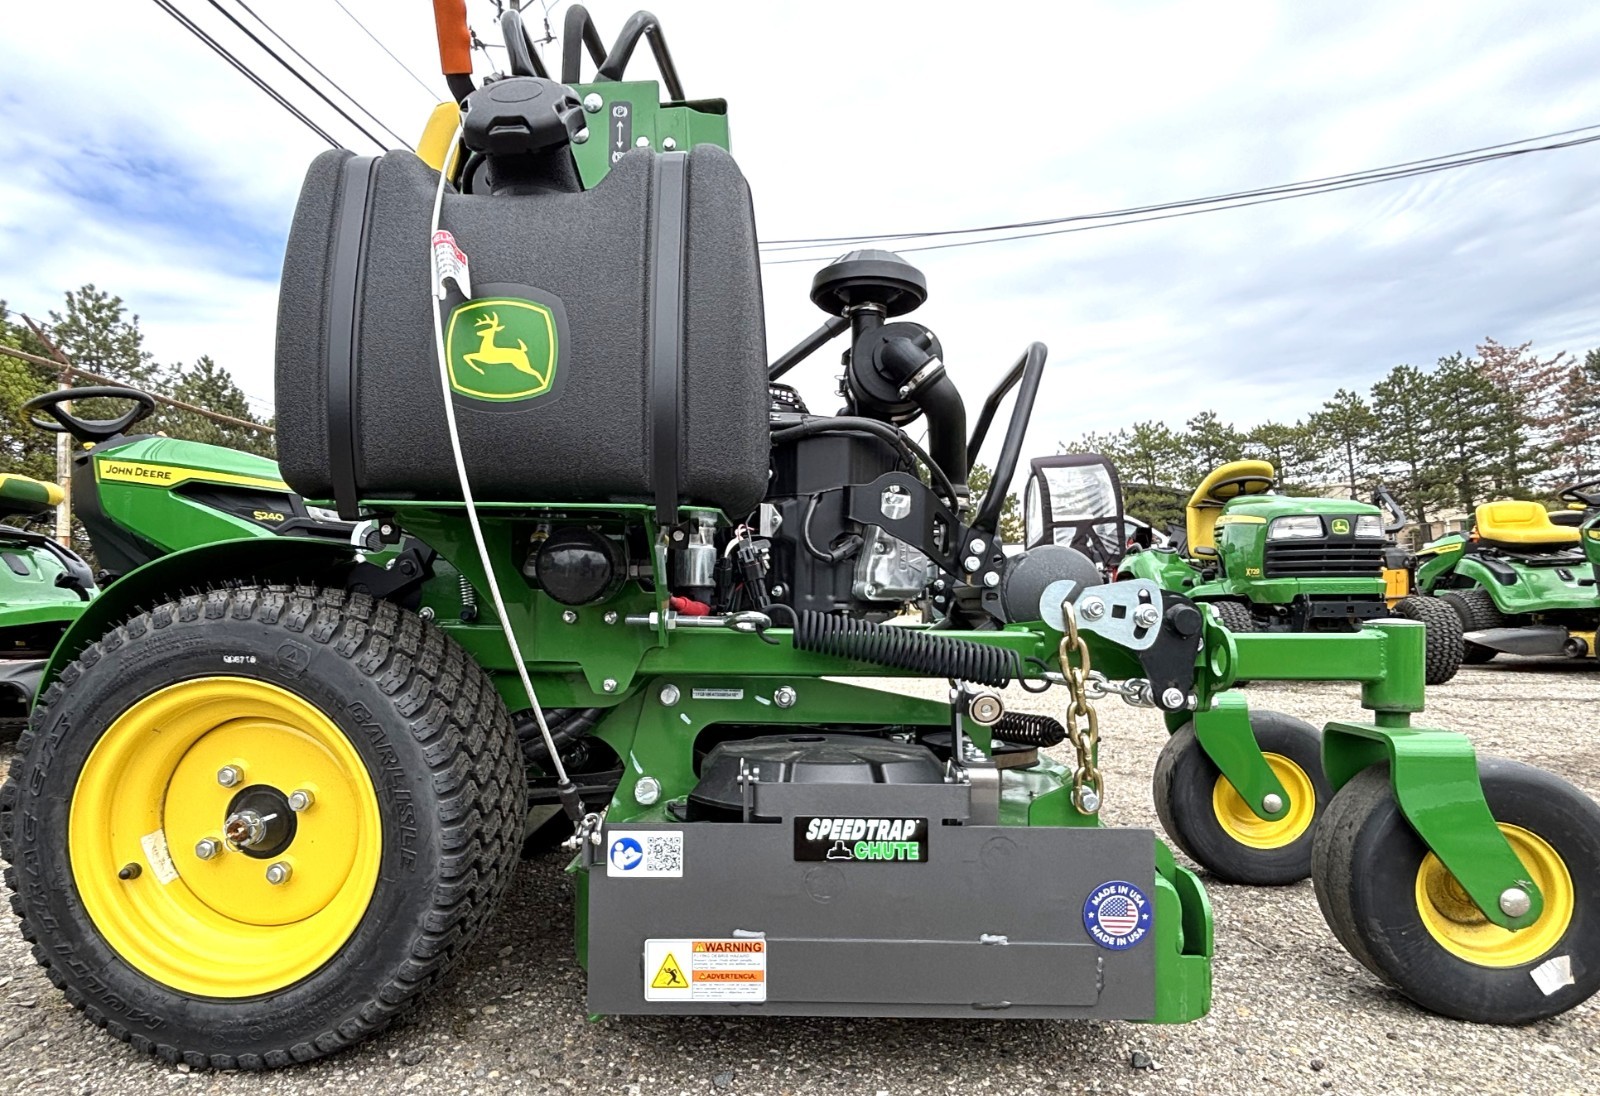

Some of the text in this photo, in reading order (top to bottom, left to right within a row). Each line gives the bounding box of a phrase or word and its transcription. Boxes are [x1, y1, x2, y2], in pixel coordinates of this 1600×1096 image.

[105, 464, 172, 480] JOHN DEERE
[253, 510, 285, 522] S240
[346, 700, 418, 873] CARLISLE
[805, 818, 916, 841] SPEEDTRAP
[854, 841, 920, 860] CHUTE
[1091, 885, 1145, 908] MADE IN USA
[1091, 925, 1145, 946] MADE IN USA
[705, 942, 762, 952] WARNING
[54, 944, 164, 1030] MULTI
